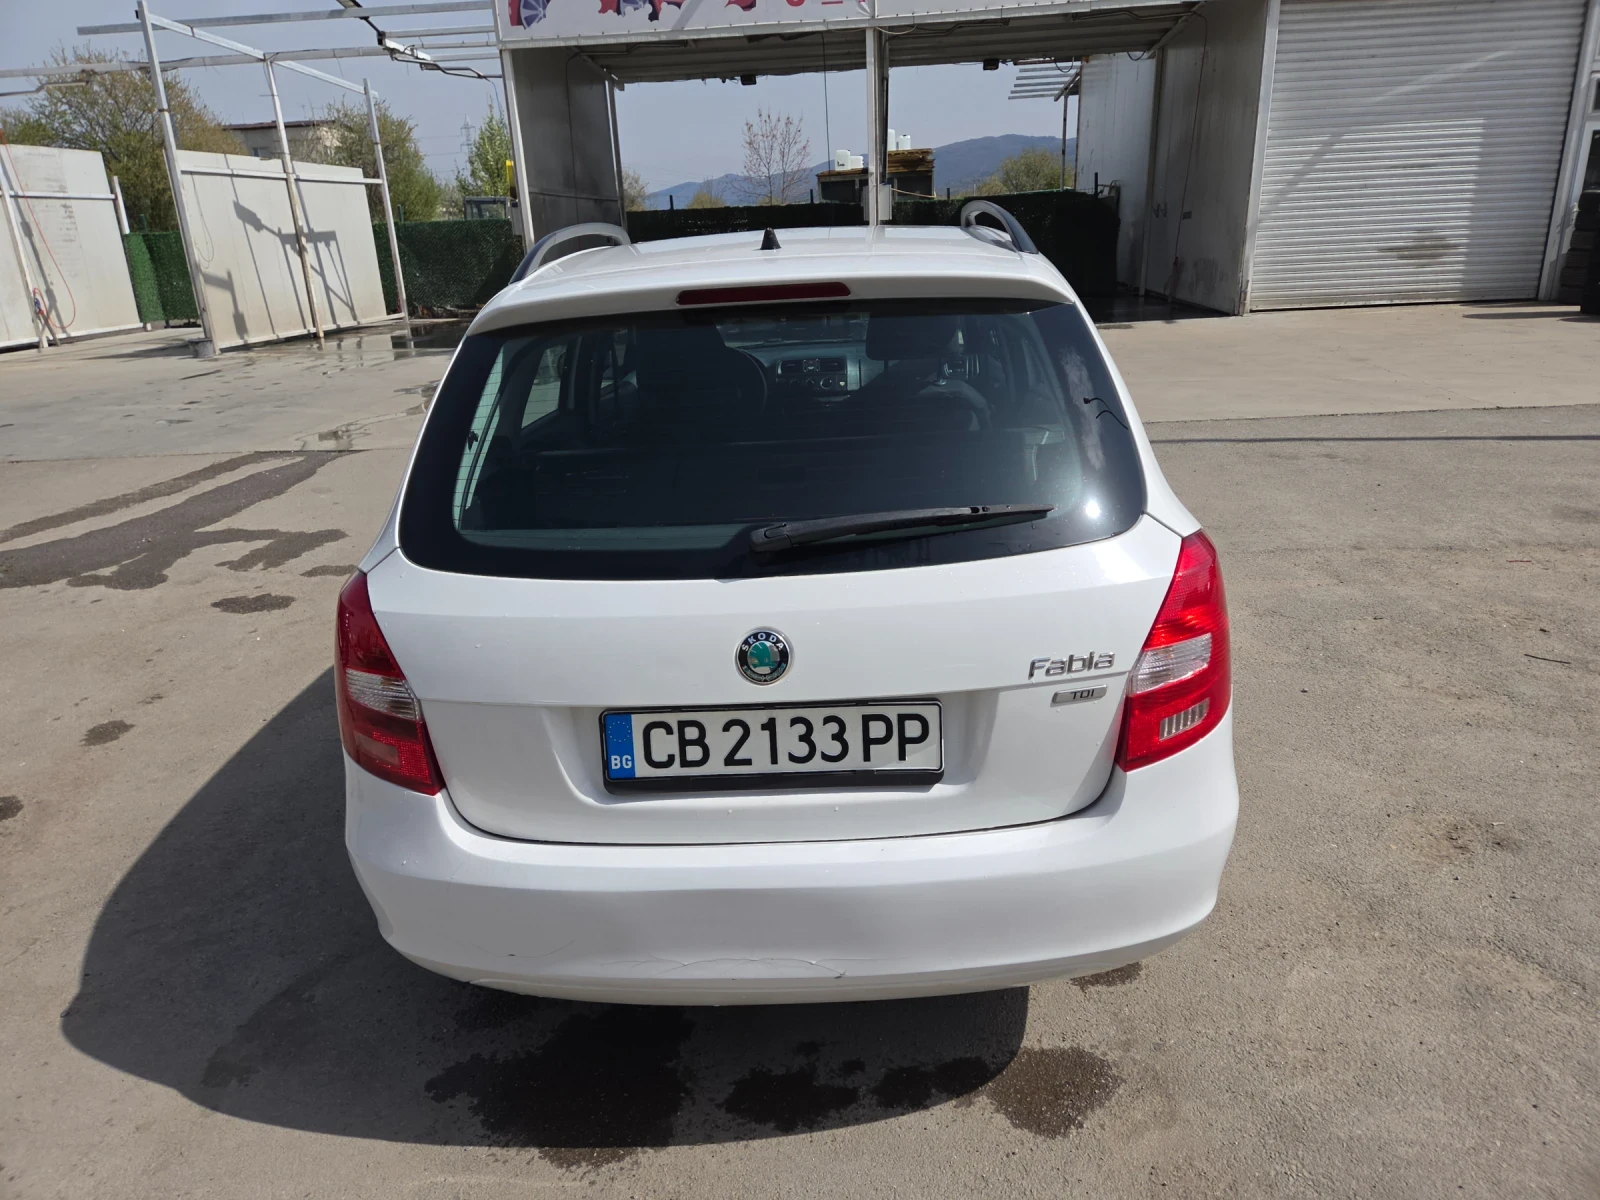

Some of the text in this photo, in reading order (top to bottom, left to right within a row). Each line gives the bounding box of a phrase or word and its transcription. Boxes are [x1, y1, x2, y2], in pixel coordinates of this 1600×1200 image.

[1028, 649, 1115, 680] Fabia
[1071, 689, 1095, 700] TDI
[642, 713, 930, 769] CB 2133 PP
[610, 754, 633, 770] BG
